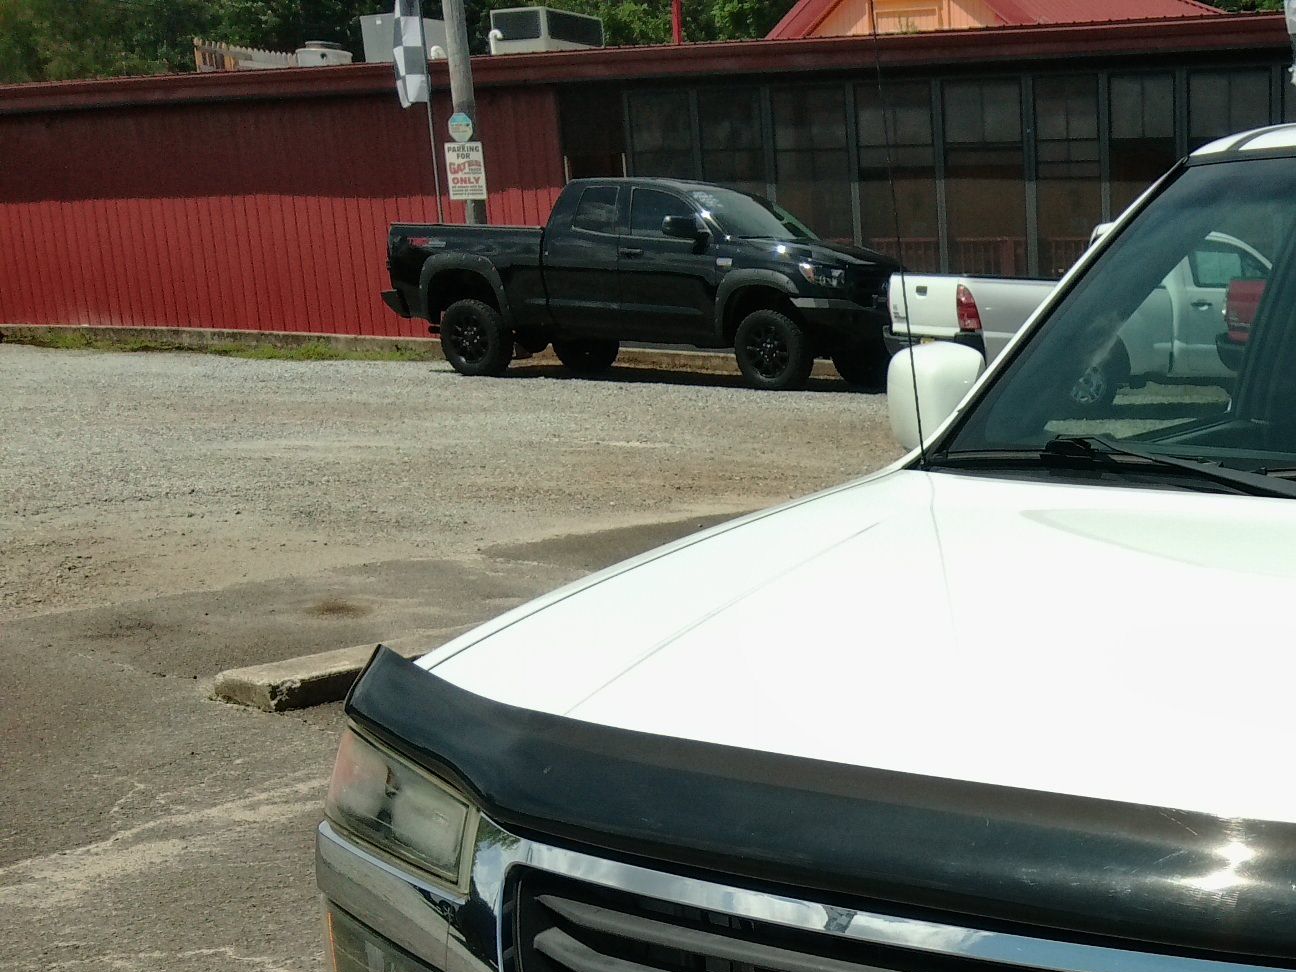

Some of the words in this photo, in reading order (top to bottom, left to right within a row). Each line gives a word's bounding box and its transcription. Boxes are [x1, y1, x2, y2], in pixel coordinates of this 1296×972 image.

[447, 145, 480, 153] PARKING
[456, 152, 471, 160] FOR
[451, 176, 481, 185] ONLY
